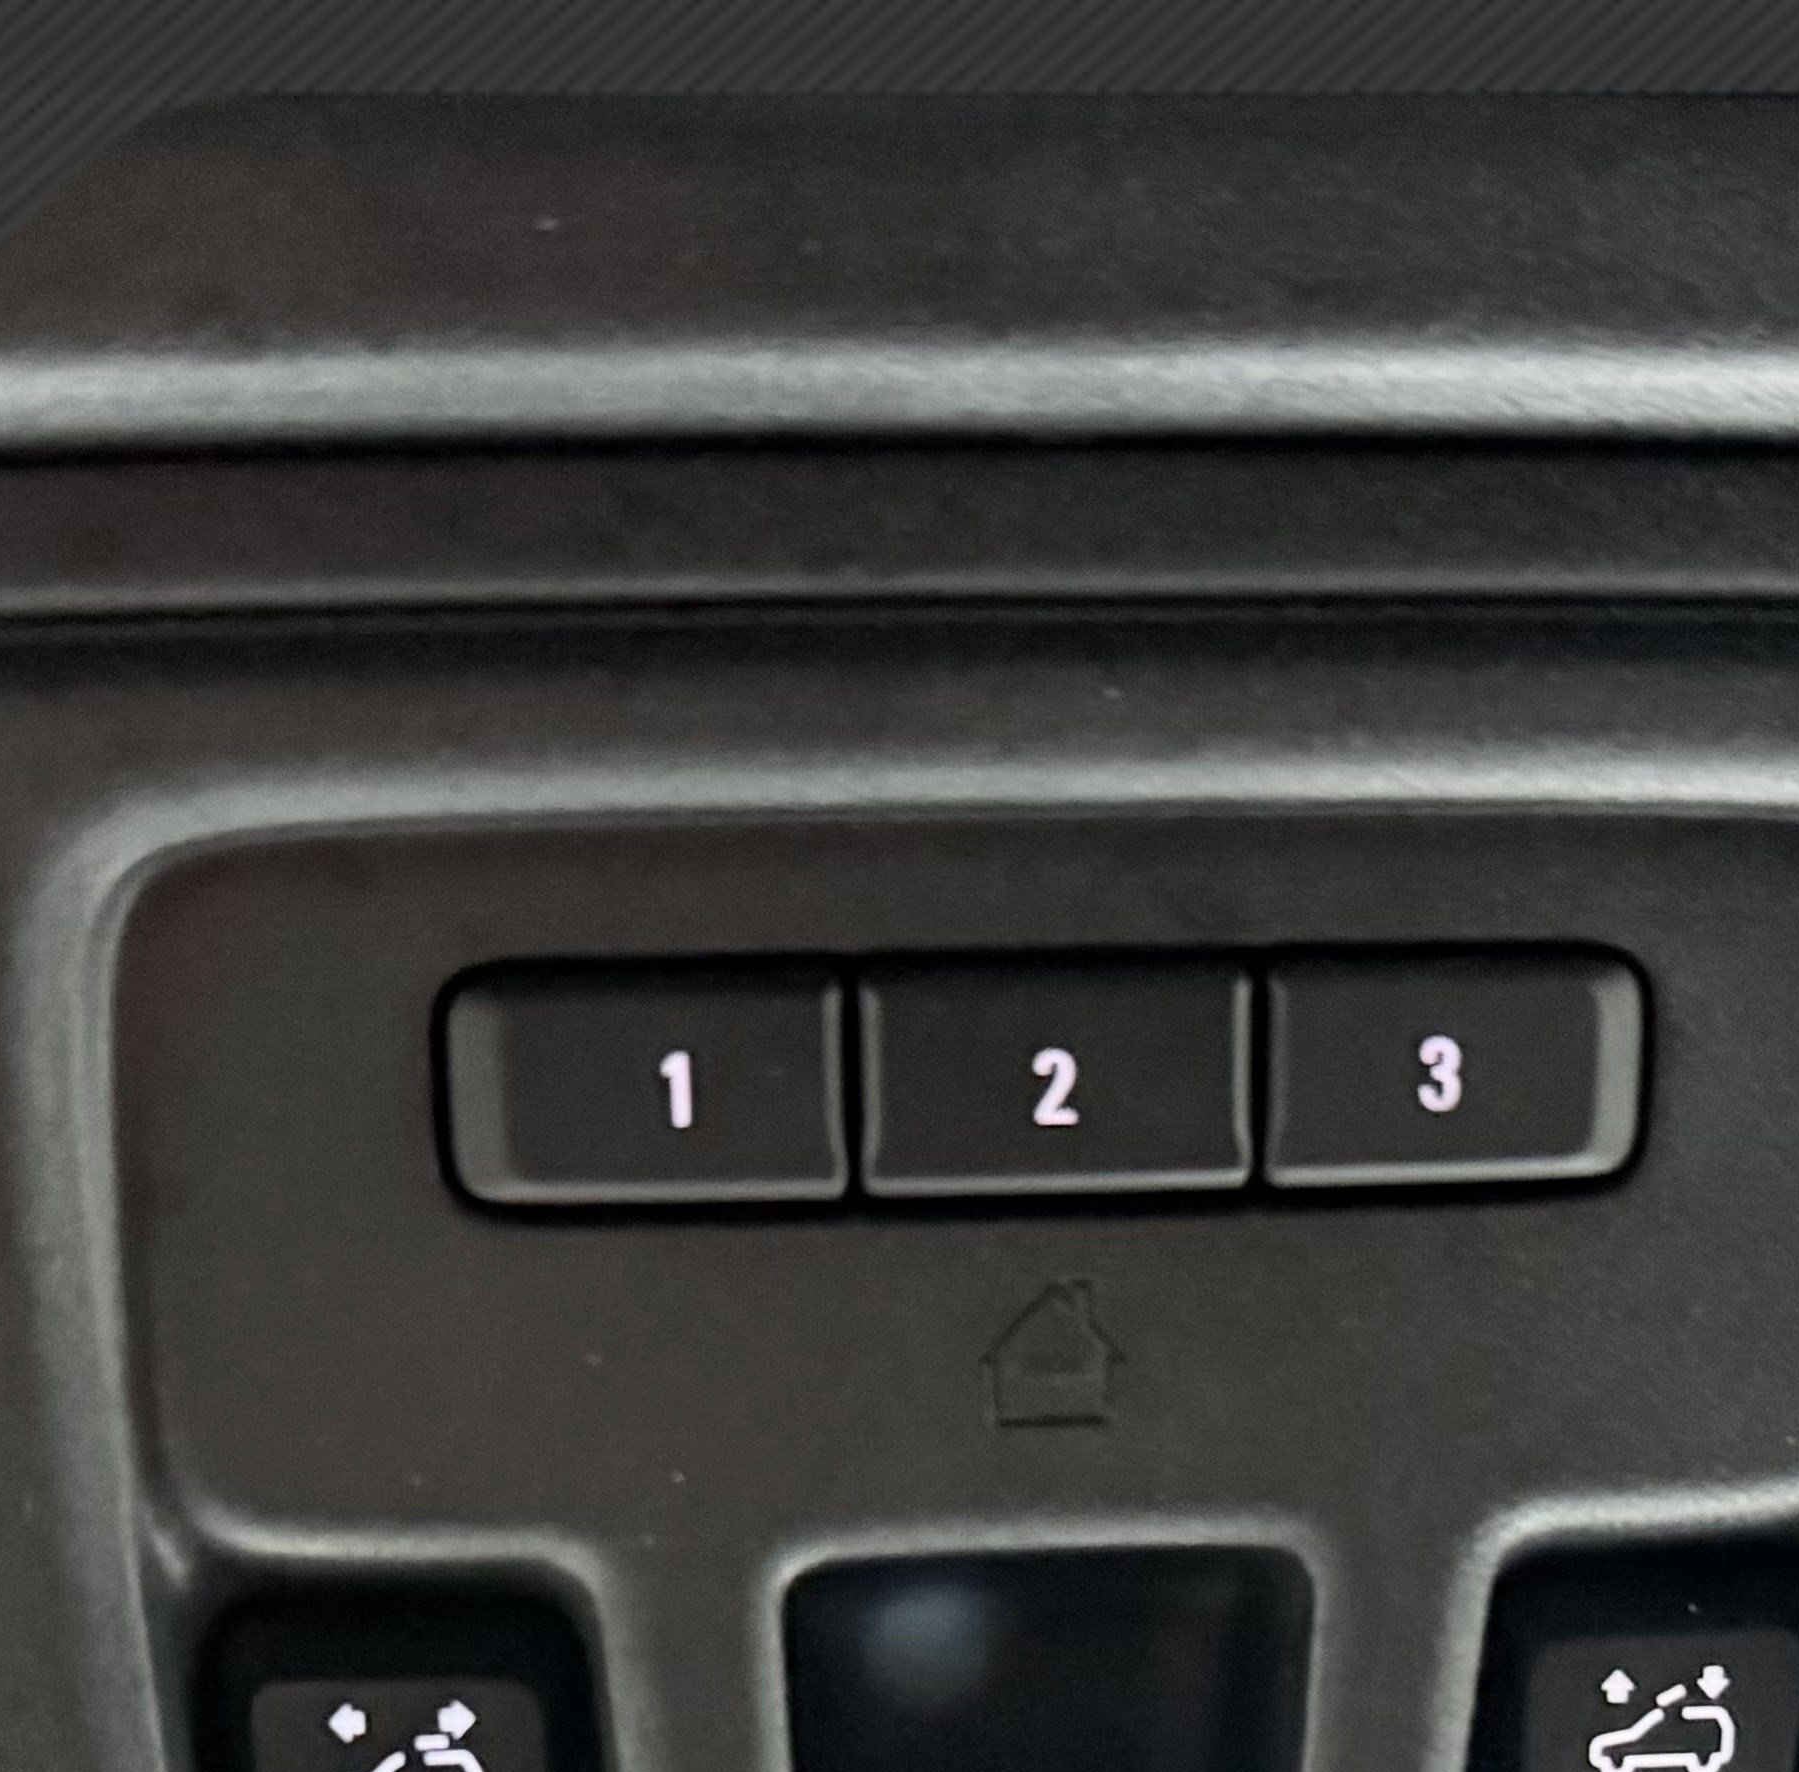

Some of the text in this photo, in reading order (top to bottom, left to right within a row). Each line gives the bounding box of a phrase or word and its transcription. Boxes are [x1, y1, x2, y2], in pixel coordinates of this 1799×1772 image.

[658, 1050, 693, 1129] 1
[1031, 1047, 1080, 1127] 2
[1416, 1035, 1463, 1113] 3
